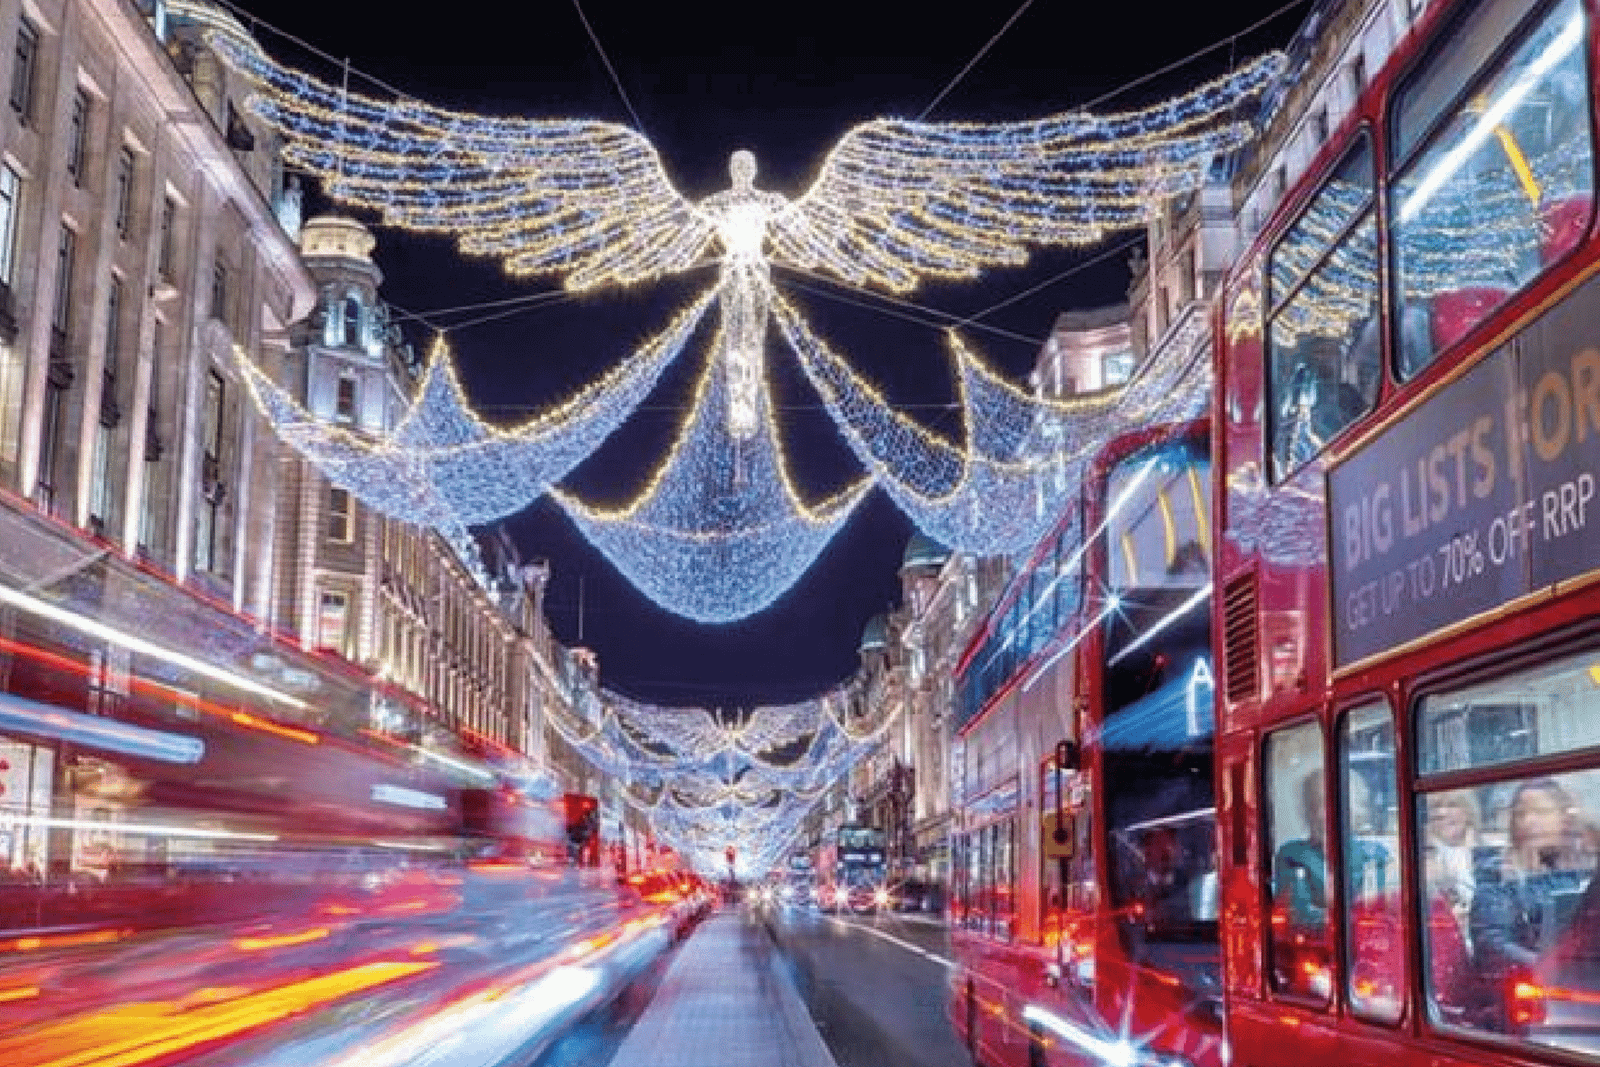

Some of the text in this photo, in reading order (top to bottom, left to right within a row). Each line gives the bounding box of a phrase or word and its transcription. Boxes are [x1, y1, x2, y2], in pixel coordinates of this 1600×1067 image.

[1344, 483, 1392, 571] BIG
[1402, 416, 1494, 537] LISTS
[1439, 531, 1484, 588] 70%
[1488, 500, 1535, 565] OFF
[1542, 473, 1594, 540] RRP
